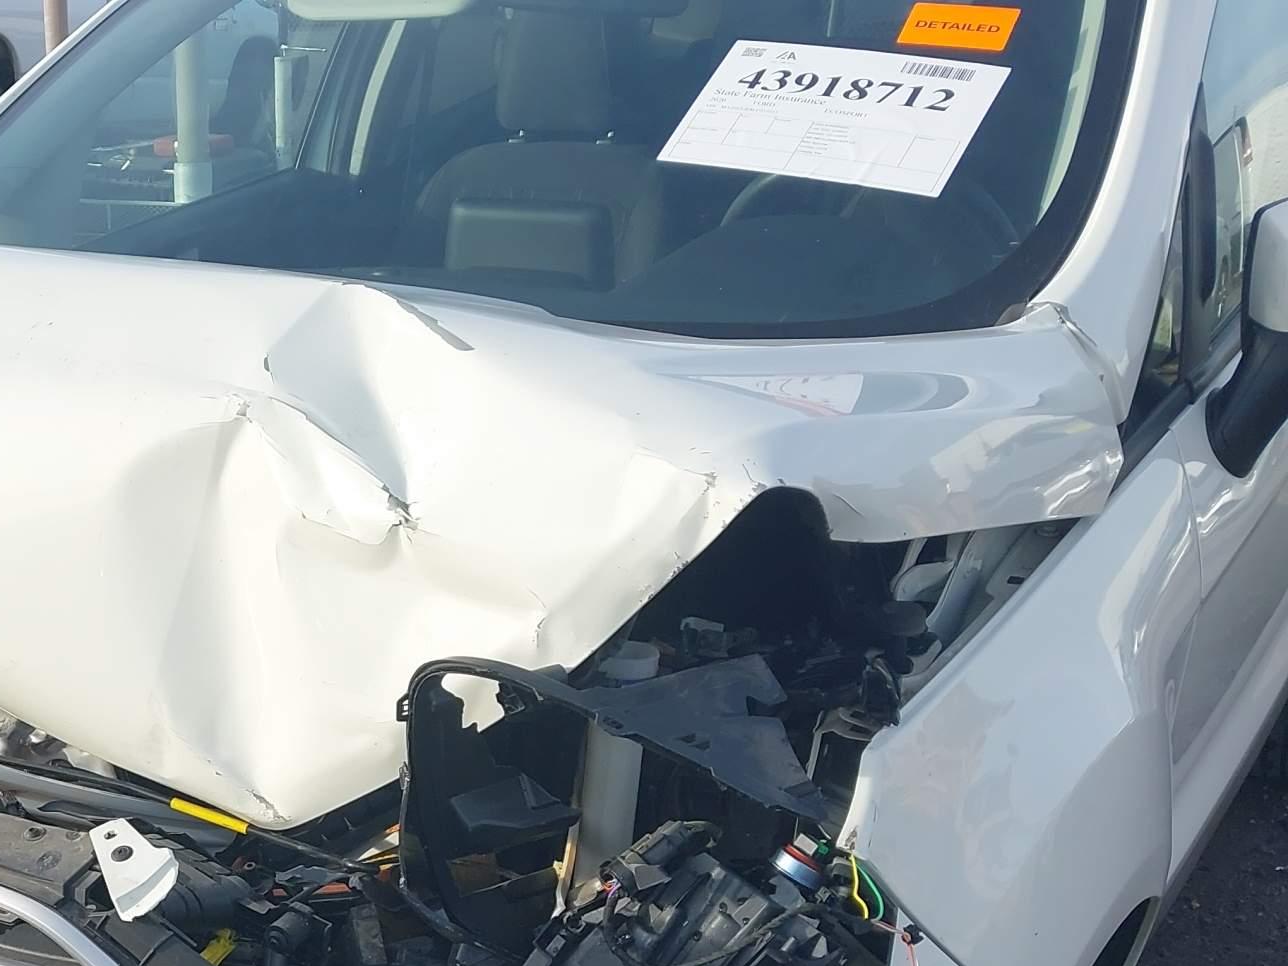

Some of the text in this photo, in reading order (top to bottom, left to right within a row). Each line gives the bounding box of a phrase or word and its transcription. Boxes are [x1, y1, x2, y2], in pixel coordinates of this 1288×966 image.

[915, 20, 1001, 33] DETAILED
[737, 68, 955, 112] 43918712
[774, 94, 827, 106] Insurance
